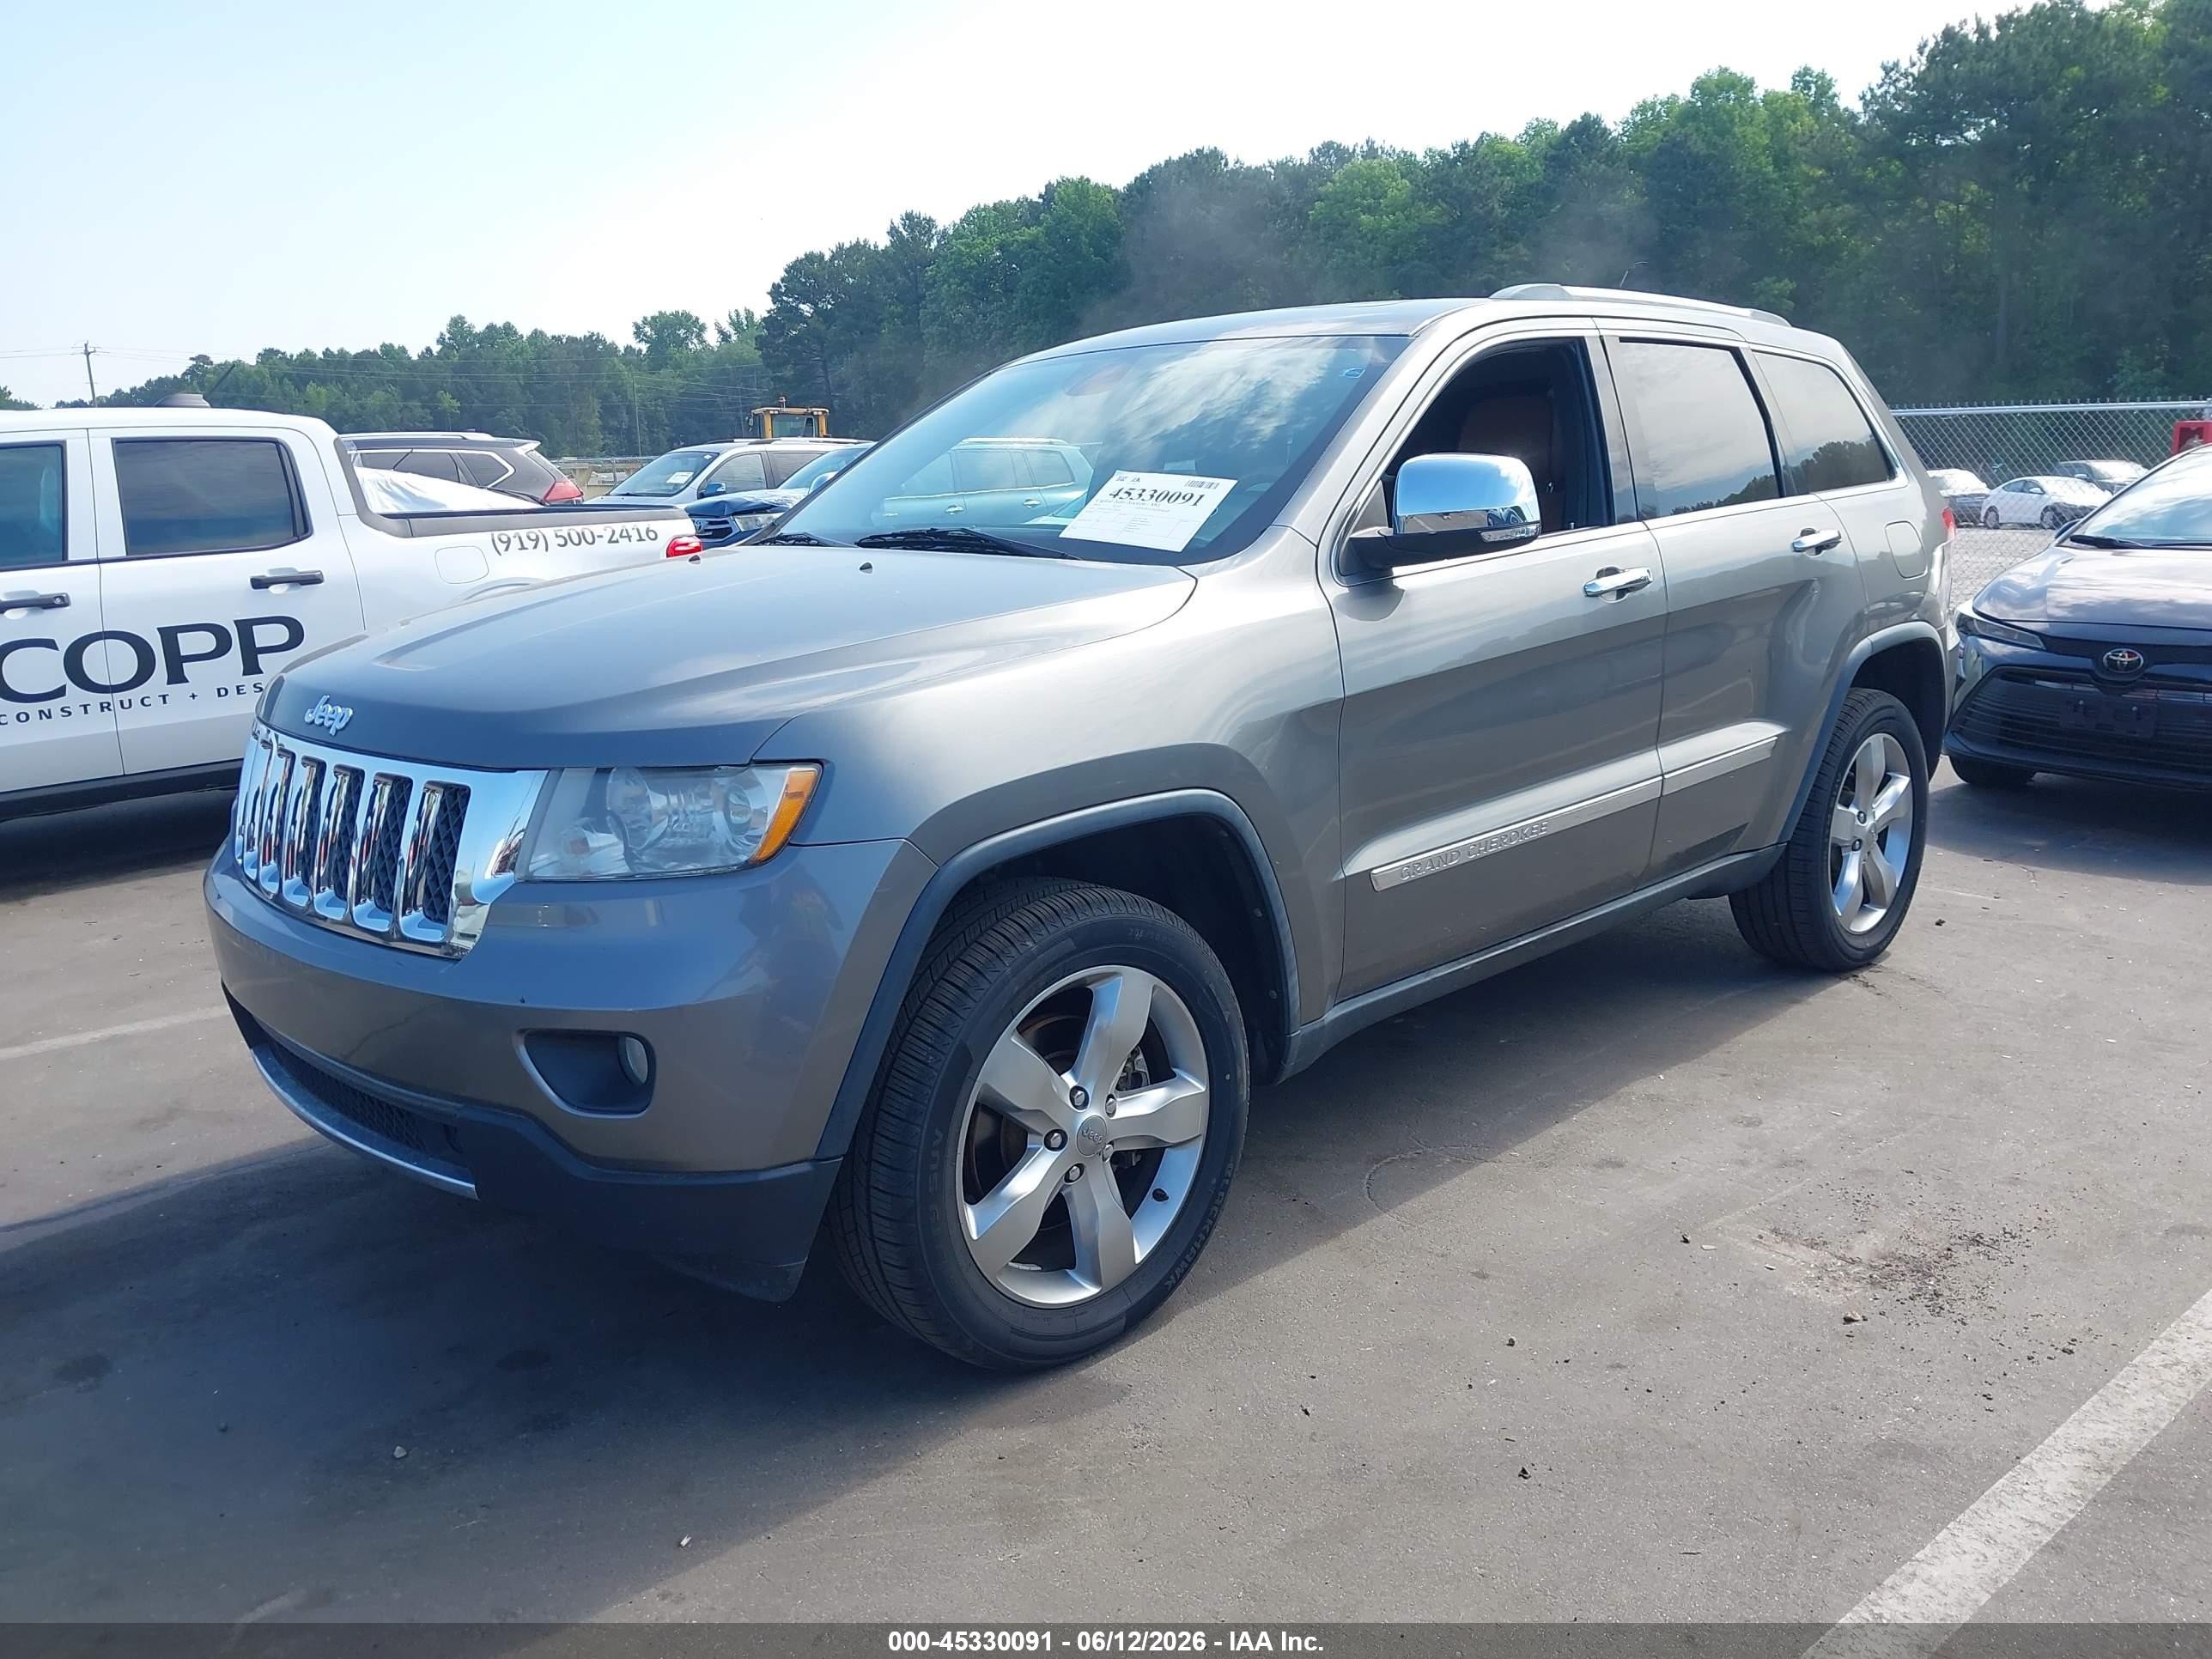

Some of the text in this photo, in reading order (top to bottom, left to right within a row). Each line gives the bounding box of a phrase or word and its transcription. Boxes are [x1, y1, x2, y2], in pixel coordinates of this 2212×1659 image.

[1109, 487, 1206, 507] 45330091
[491, 525, 658, 556] (919) 500-2416
[304, 695, 354, 736] Jeep
[1401, 822, 1548, 880] GRAND CHEROKEE
